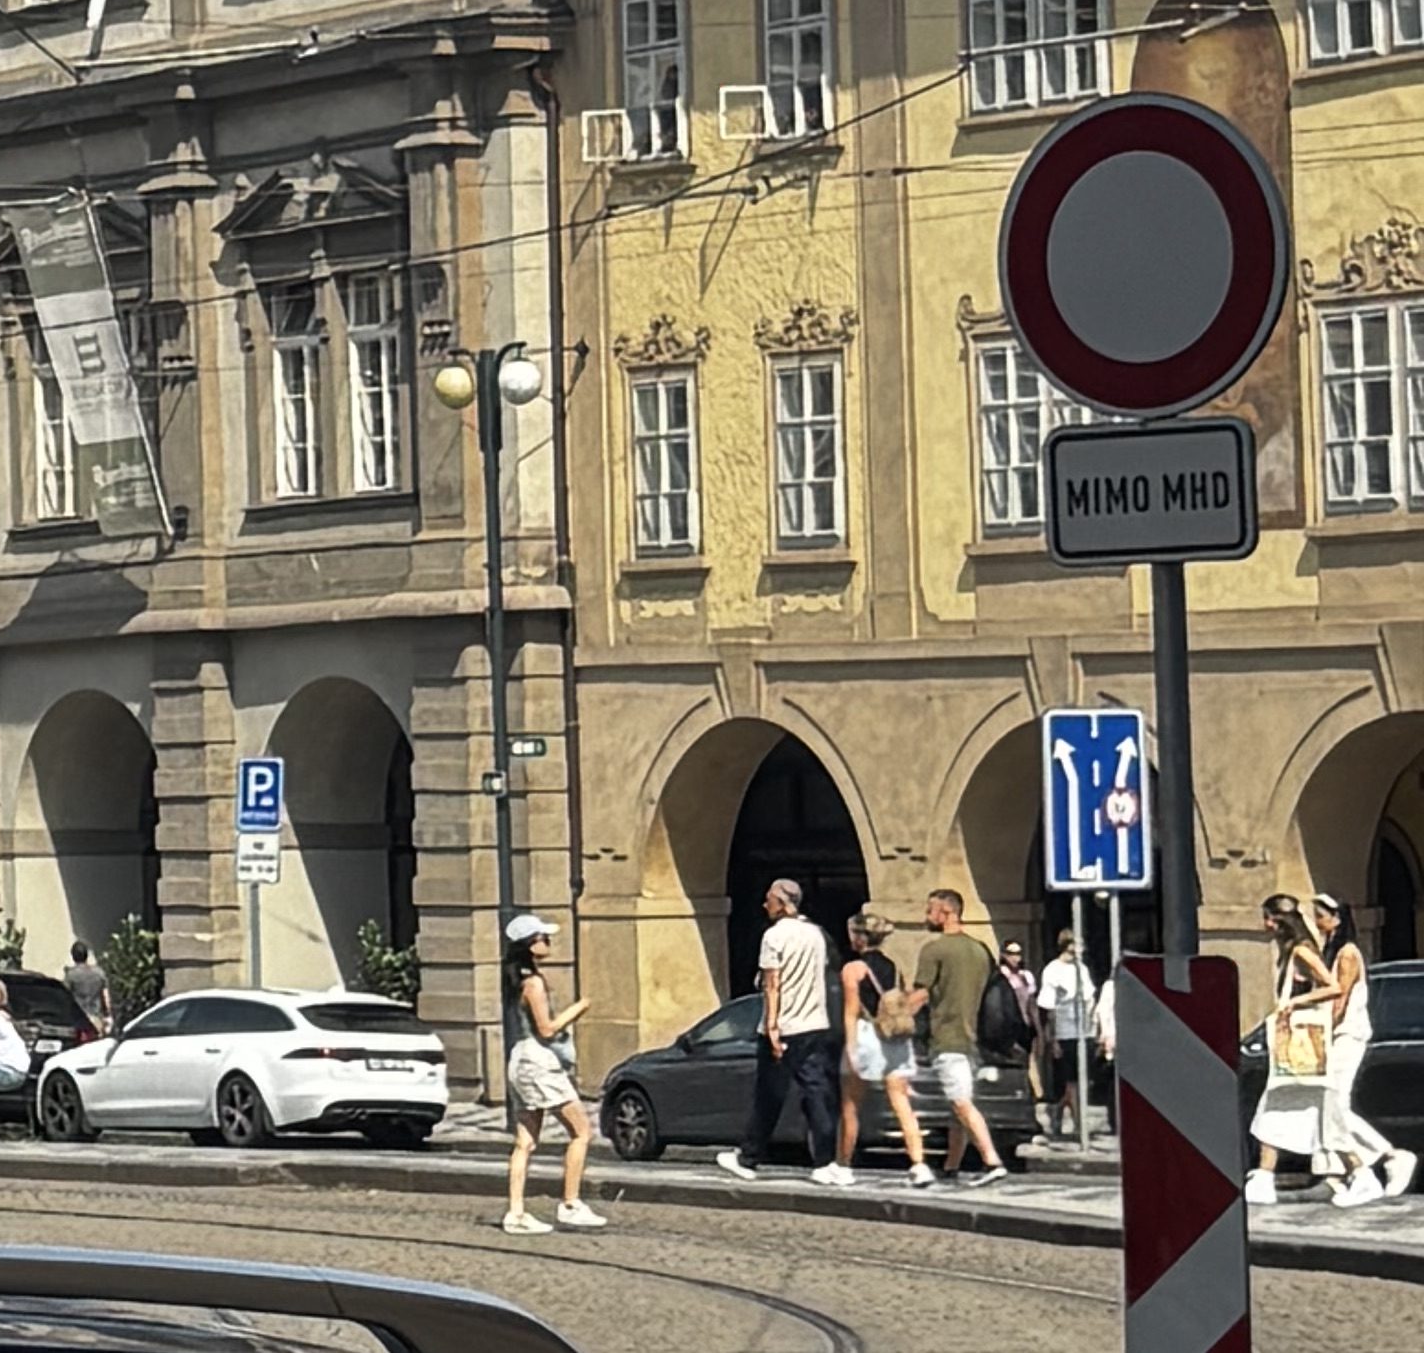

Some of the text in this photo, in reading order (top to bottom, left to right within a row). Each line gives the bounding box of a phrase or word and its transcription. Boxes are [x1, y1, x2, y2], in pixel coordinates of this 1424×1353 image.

[1066, 470, 1231, 518] MIMO MHD
[247, 766, 274, 807] P
